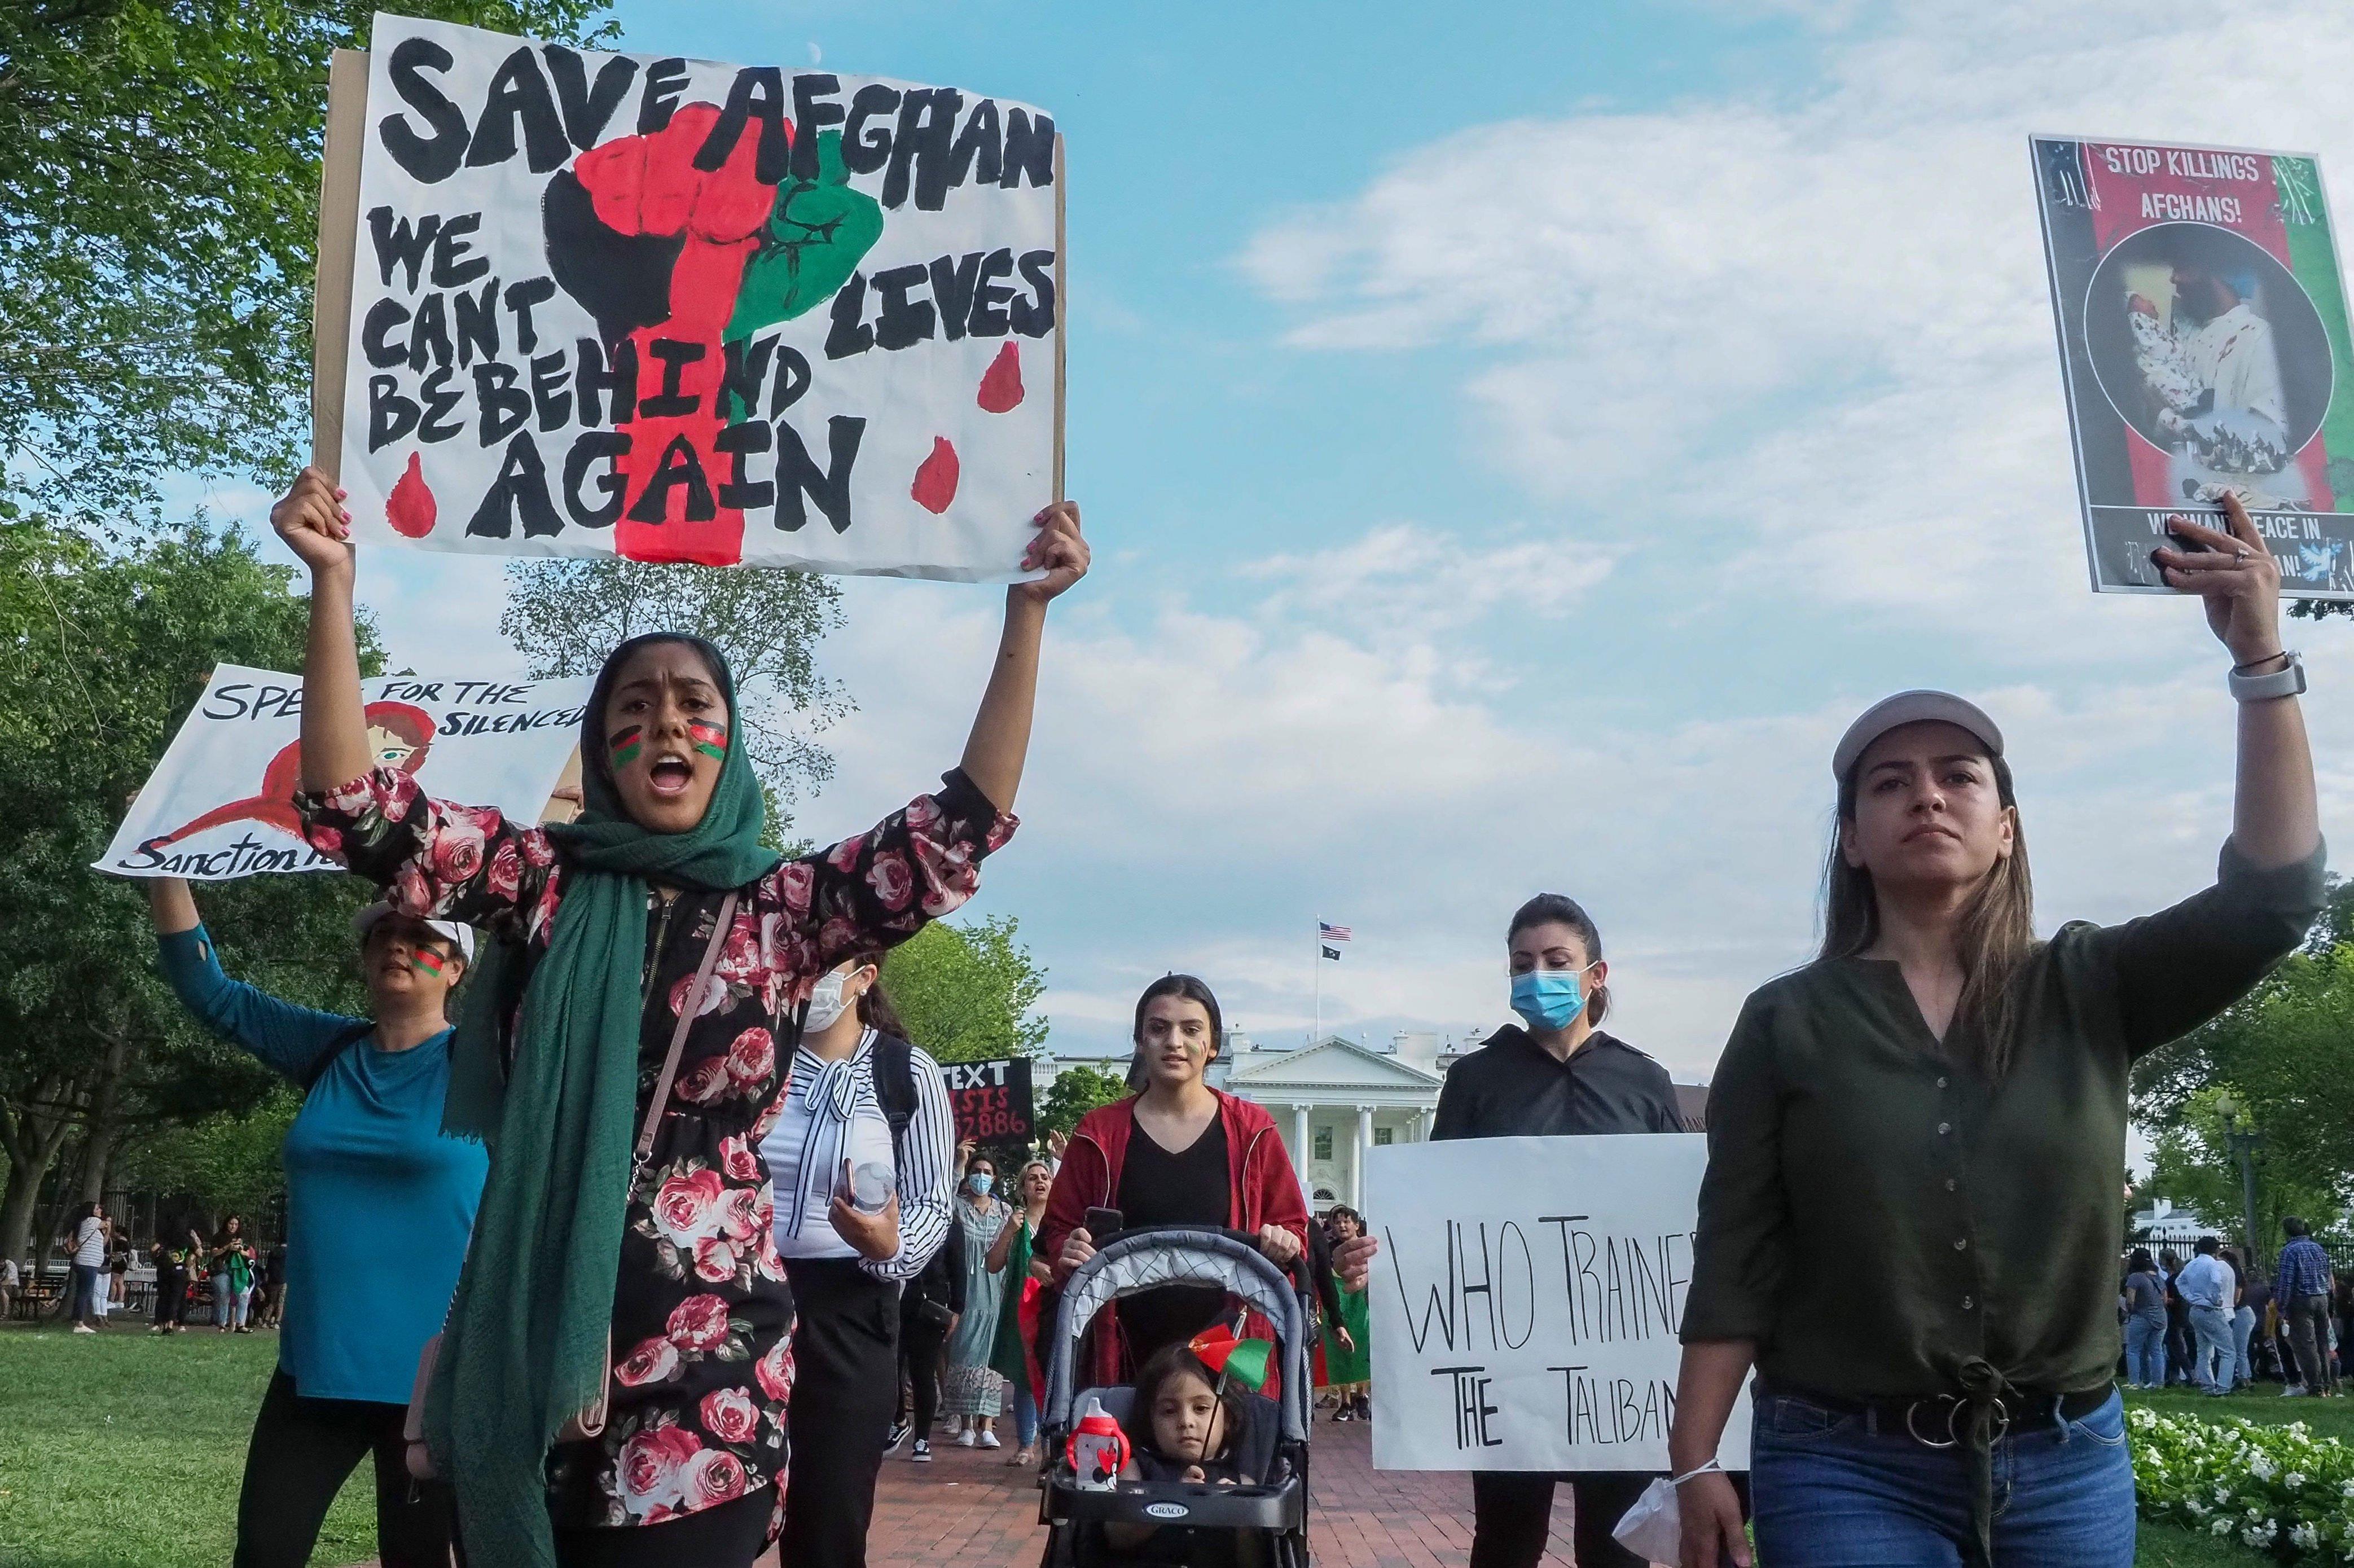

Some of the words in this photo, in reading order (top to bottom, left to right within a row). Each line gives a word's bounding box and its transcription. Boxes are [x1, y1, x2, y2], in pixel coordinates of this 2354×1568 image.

[379, 36, 691, 185] SAVE
[692, 67, 1056, 211] AFGHAN
[2105, 147, 2161, 175] STOP
[2168, 151, 2259, 182] KILLINGS
[2141, 193, 2242, 223] AFGHANS!
[367, 206, 490, 294] WE
[825, 249, 1056, 360] LIVES
[368, 366, 465, 454] BE
[472, 333, 811, 448] BEHIND
[465, 416, 868, 539] AGAIN
[2251, 516, 2299, 539] EACE
[2302, 518, 2321, 539] IN
[380, 682, 444, 702] FOR
[455, 682, 537, 705] THE
[117, 832, 298, 876] Sanction
[940, 1060, 1010, 1090] TEXT
[1385, 1220, 1534, 1354] WHO
[1538, 1215, 1697, 1346] TRAINE
[1430, 1366, 1503, 1450] THE
[1151, 1505, 1185, 1515] GRACO
